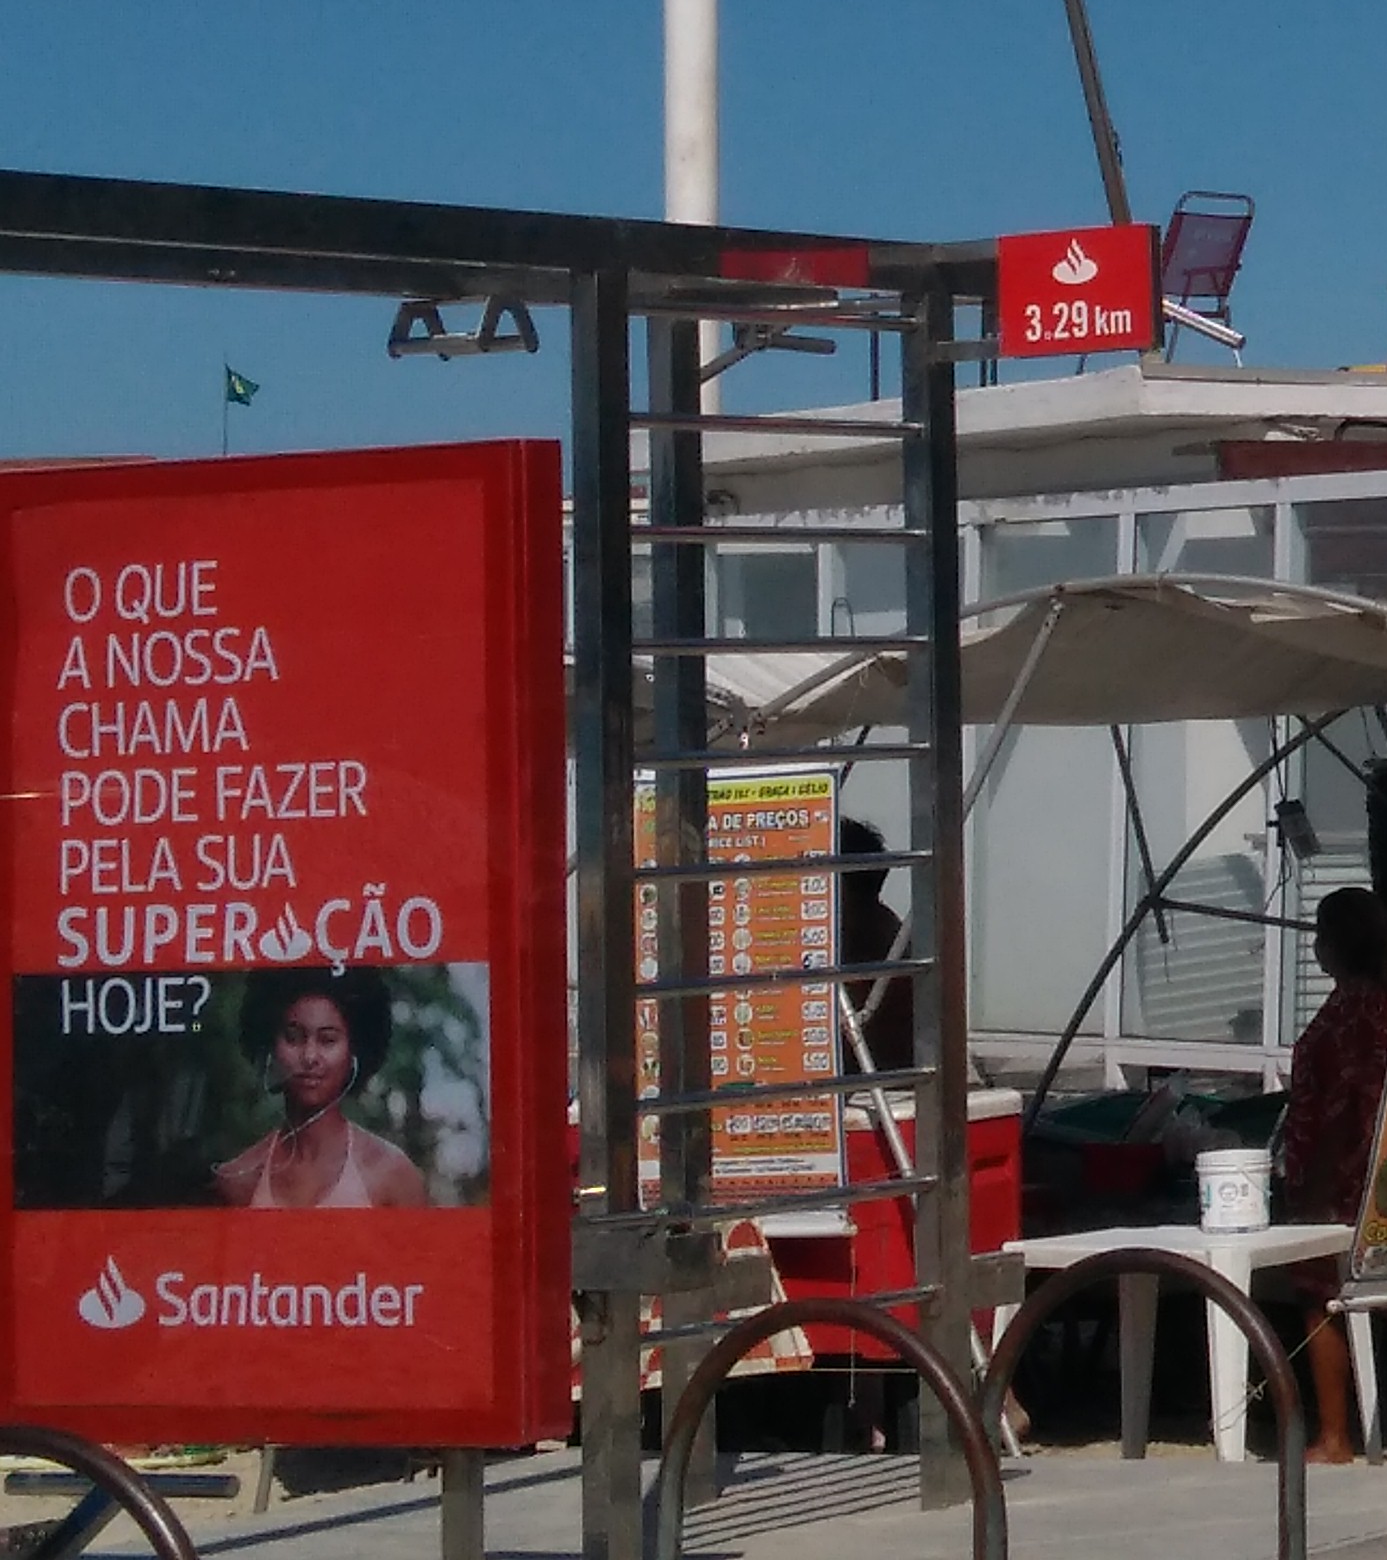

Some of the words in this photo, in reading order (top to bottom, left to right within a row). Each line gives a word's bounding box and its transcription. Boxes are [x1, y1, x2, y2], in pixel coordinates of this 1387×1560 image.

[1024, 301, 1088, 342] 3.29
[1096, 306, 1132, 336] km
[64, 567, 100, 622] O
[115, 560, 218, 624] QUE
[57, 637, 91, 689] A
[106, 627, 279, 688] NOSSA
[58, 698, 249, 757] CHAMA
[61, 767, 198, 826] PODE
[216, 761, 367, 820] FAZER
[747, 809, 809, 830] PREÇOS
[60, 838, 182, 894] PELA
[197, 834, 297, 890] SUA
[61, 976, 211, 1035] HOJE?
[156, 1272, 423, 1328] Santander
